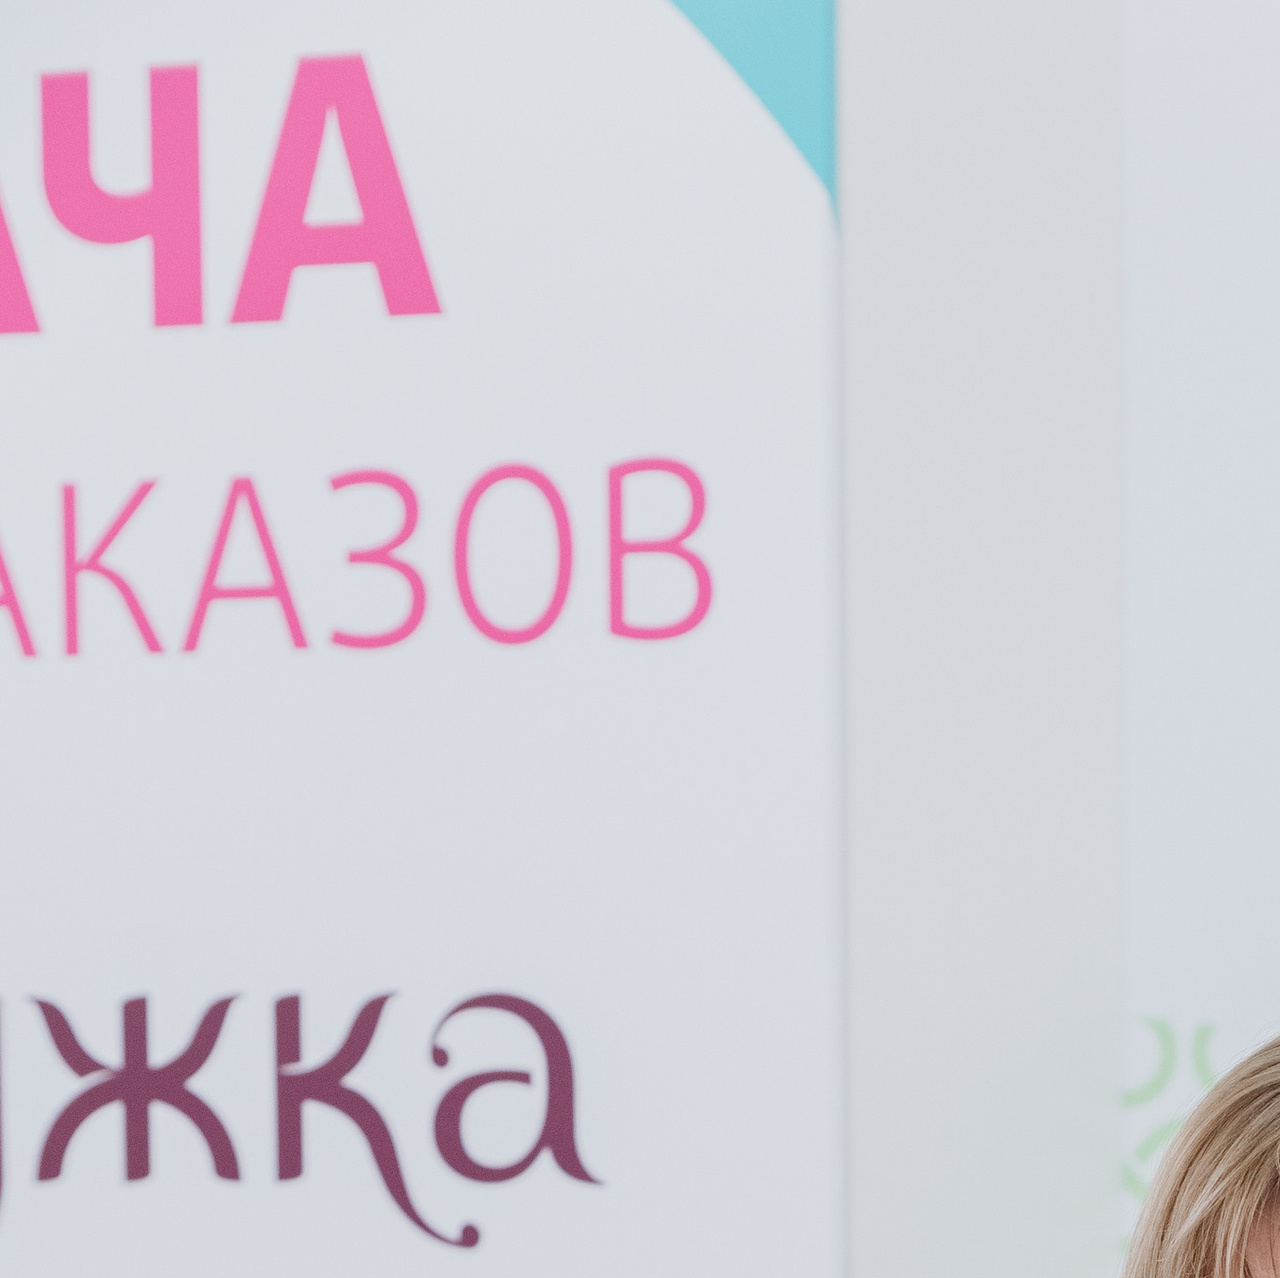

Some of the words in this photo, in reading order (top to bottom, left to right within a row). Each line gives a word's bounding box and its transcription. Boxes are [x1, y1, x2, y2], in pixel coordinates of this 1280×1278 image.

[0, 53, 442, 334] ЧА
[0, 457, 713, 658] КАЗОВ
[0, 990, 604, 1249] жка
